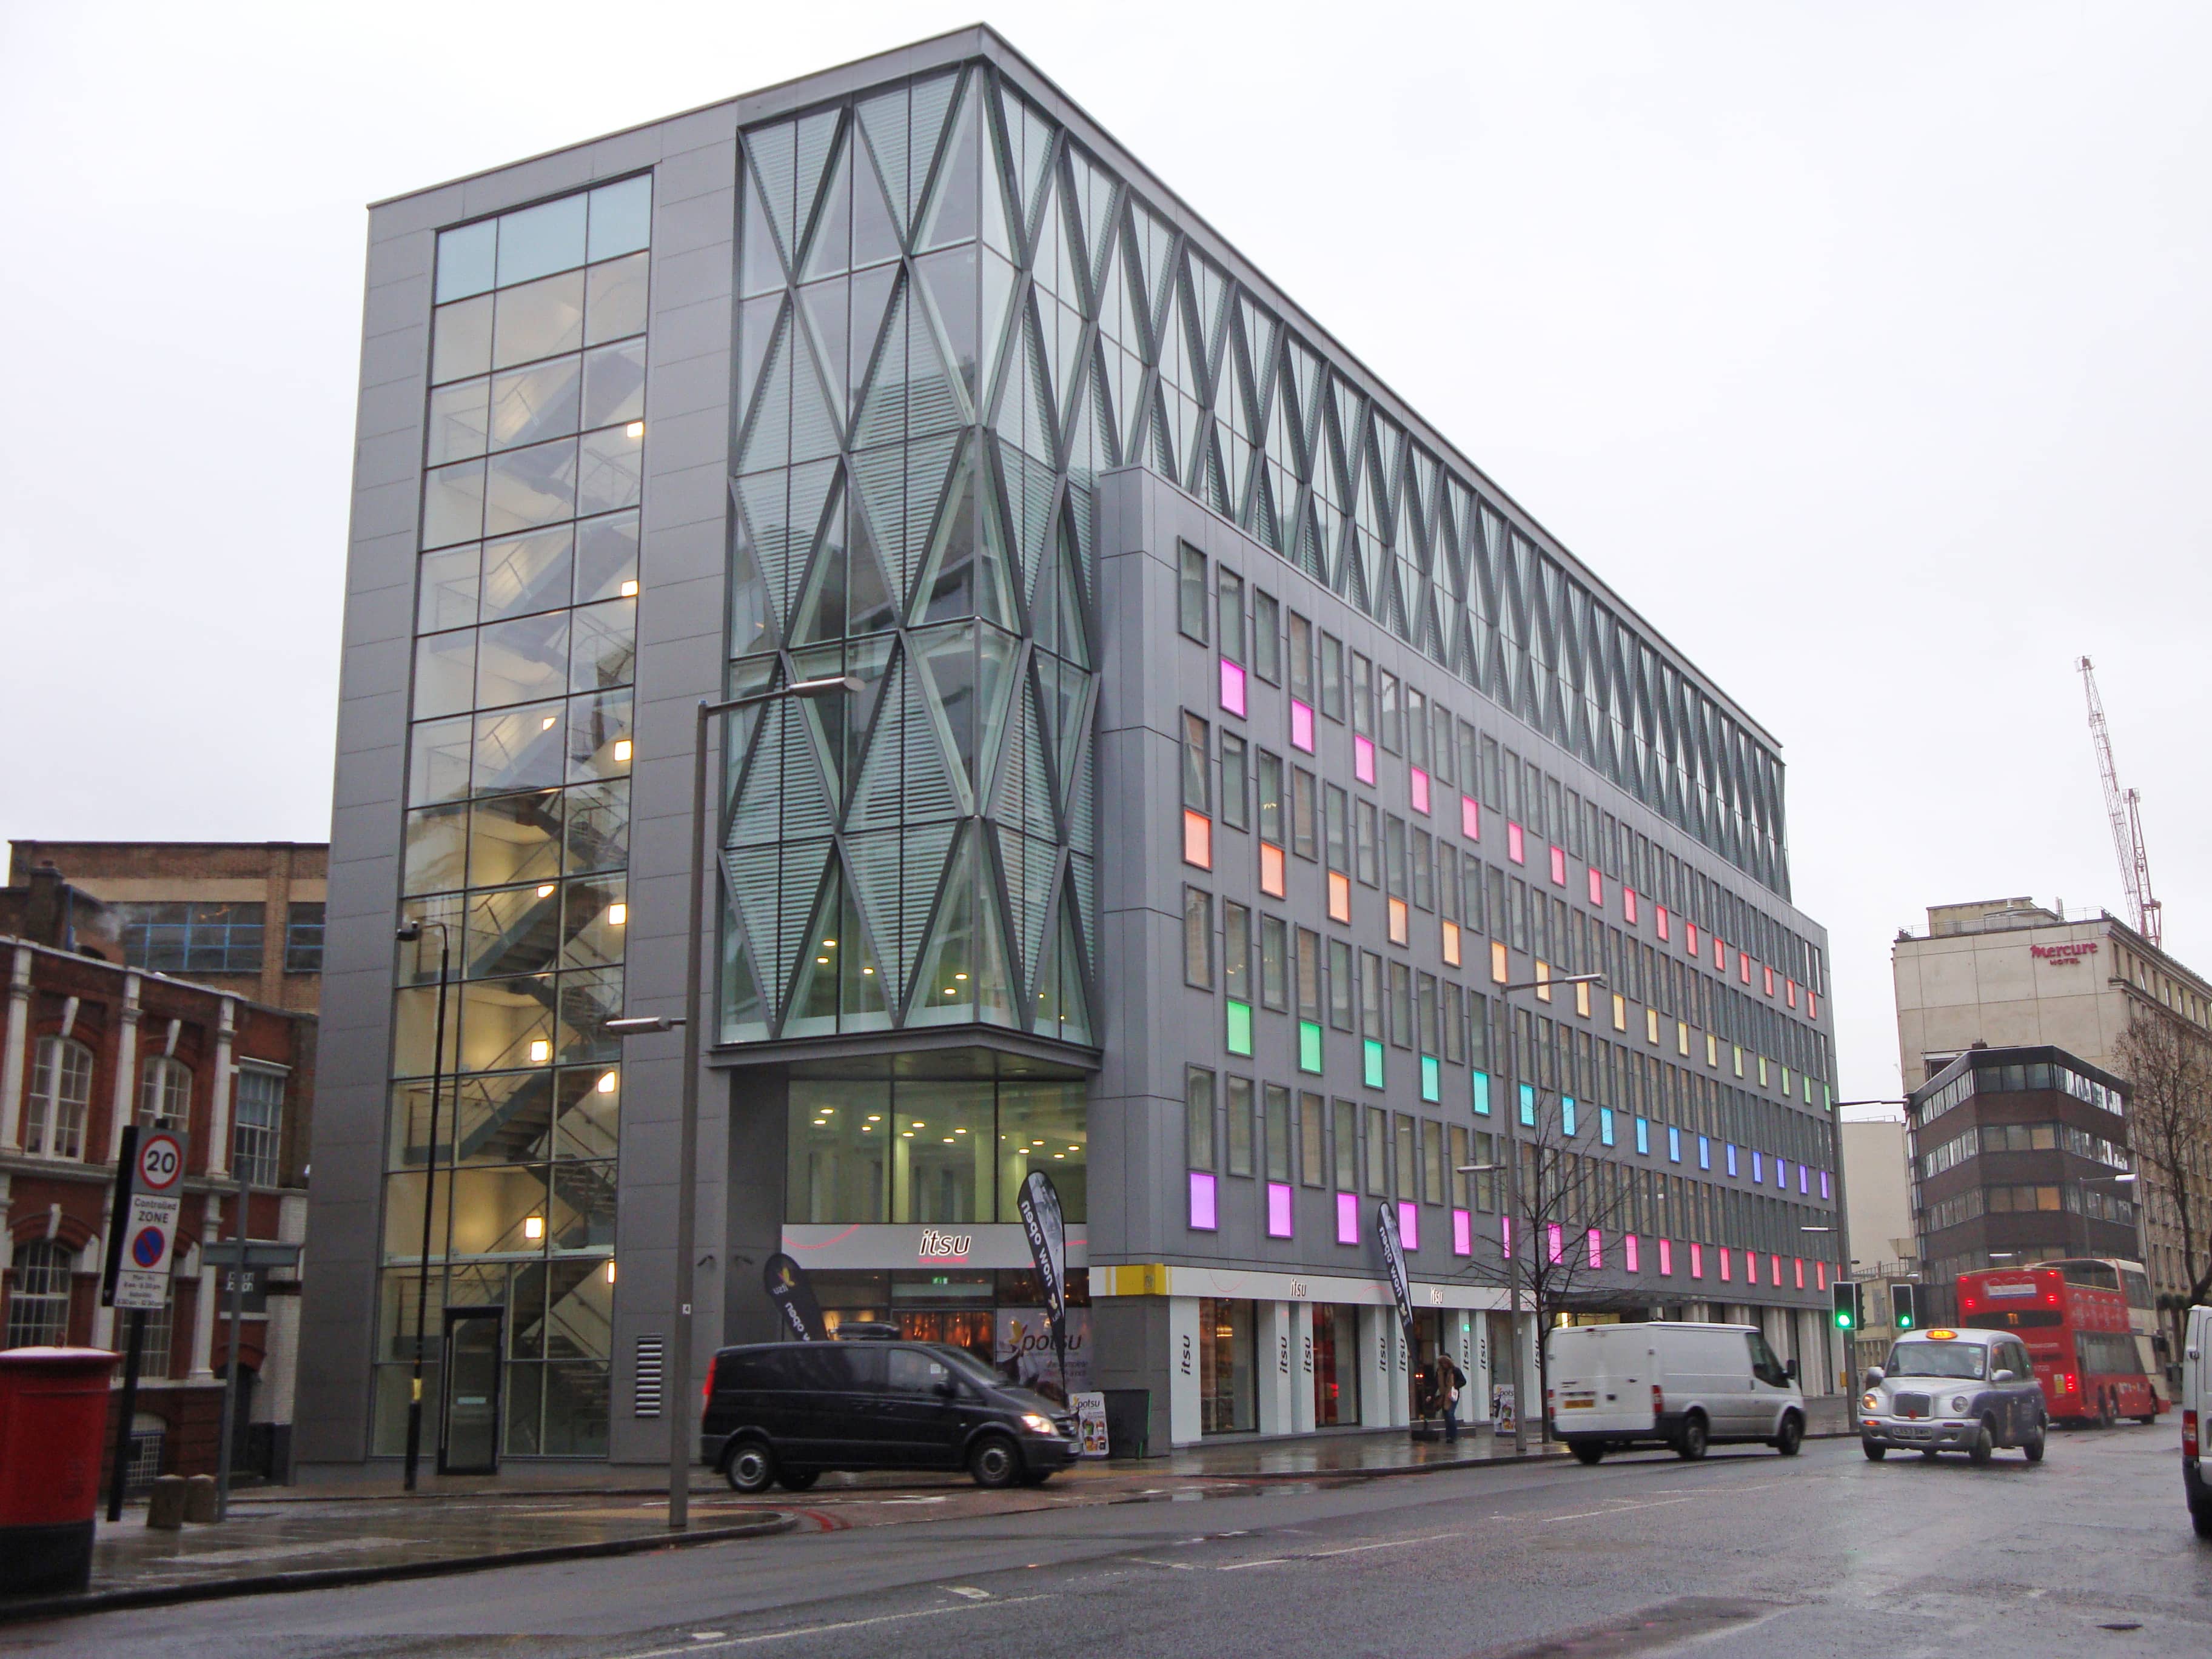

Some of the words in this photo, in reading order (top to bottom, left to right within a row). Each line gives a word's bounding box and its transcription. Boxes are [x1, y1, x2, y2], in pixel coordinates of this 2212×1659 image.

[147, 1150, 175, 1173] 20
[135, 1198, 177, 1210] Controlled
[138, 1210, 169, 1223] ZONE
[919, 1228, 971, 1256] itsu
[1290, 1278, 1306, 1296] itsu
[1430, 1287, 1443, 1304] itsu
[1181, 1335, 1191, 1375] itsu
[1279, 1336, 1288, 1374] itsu
[1077, 1398, 1101, 1412] potsu
